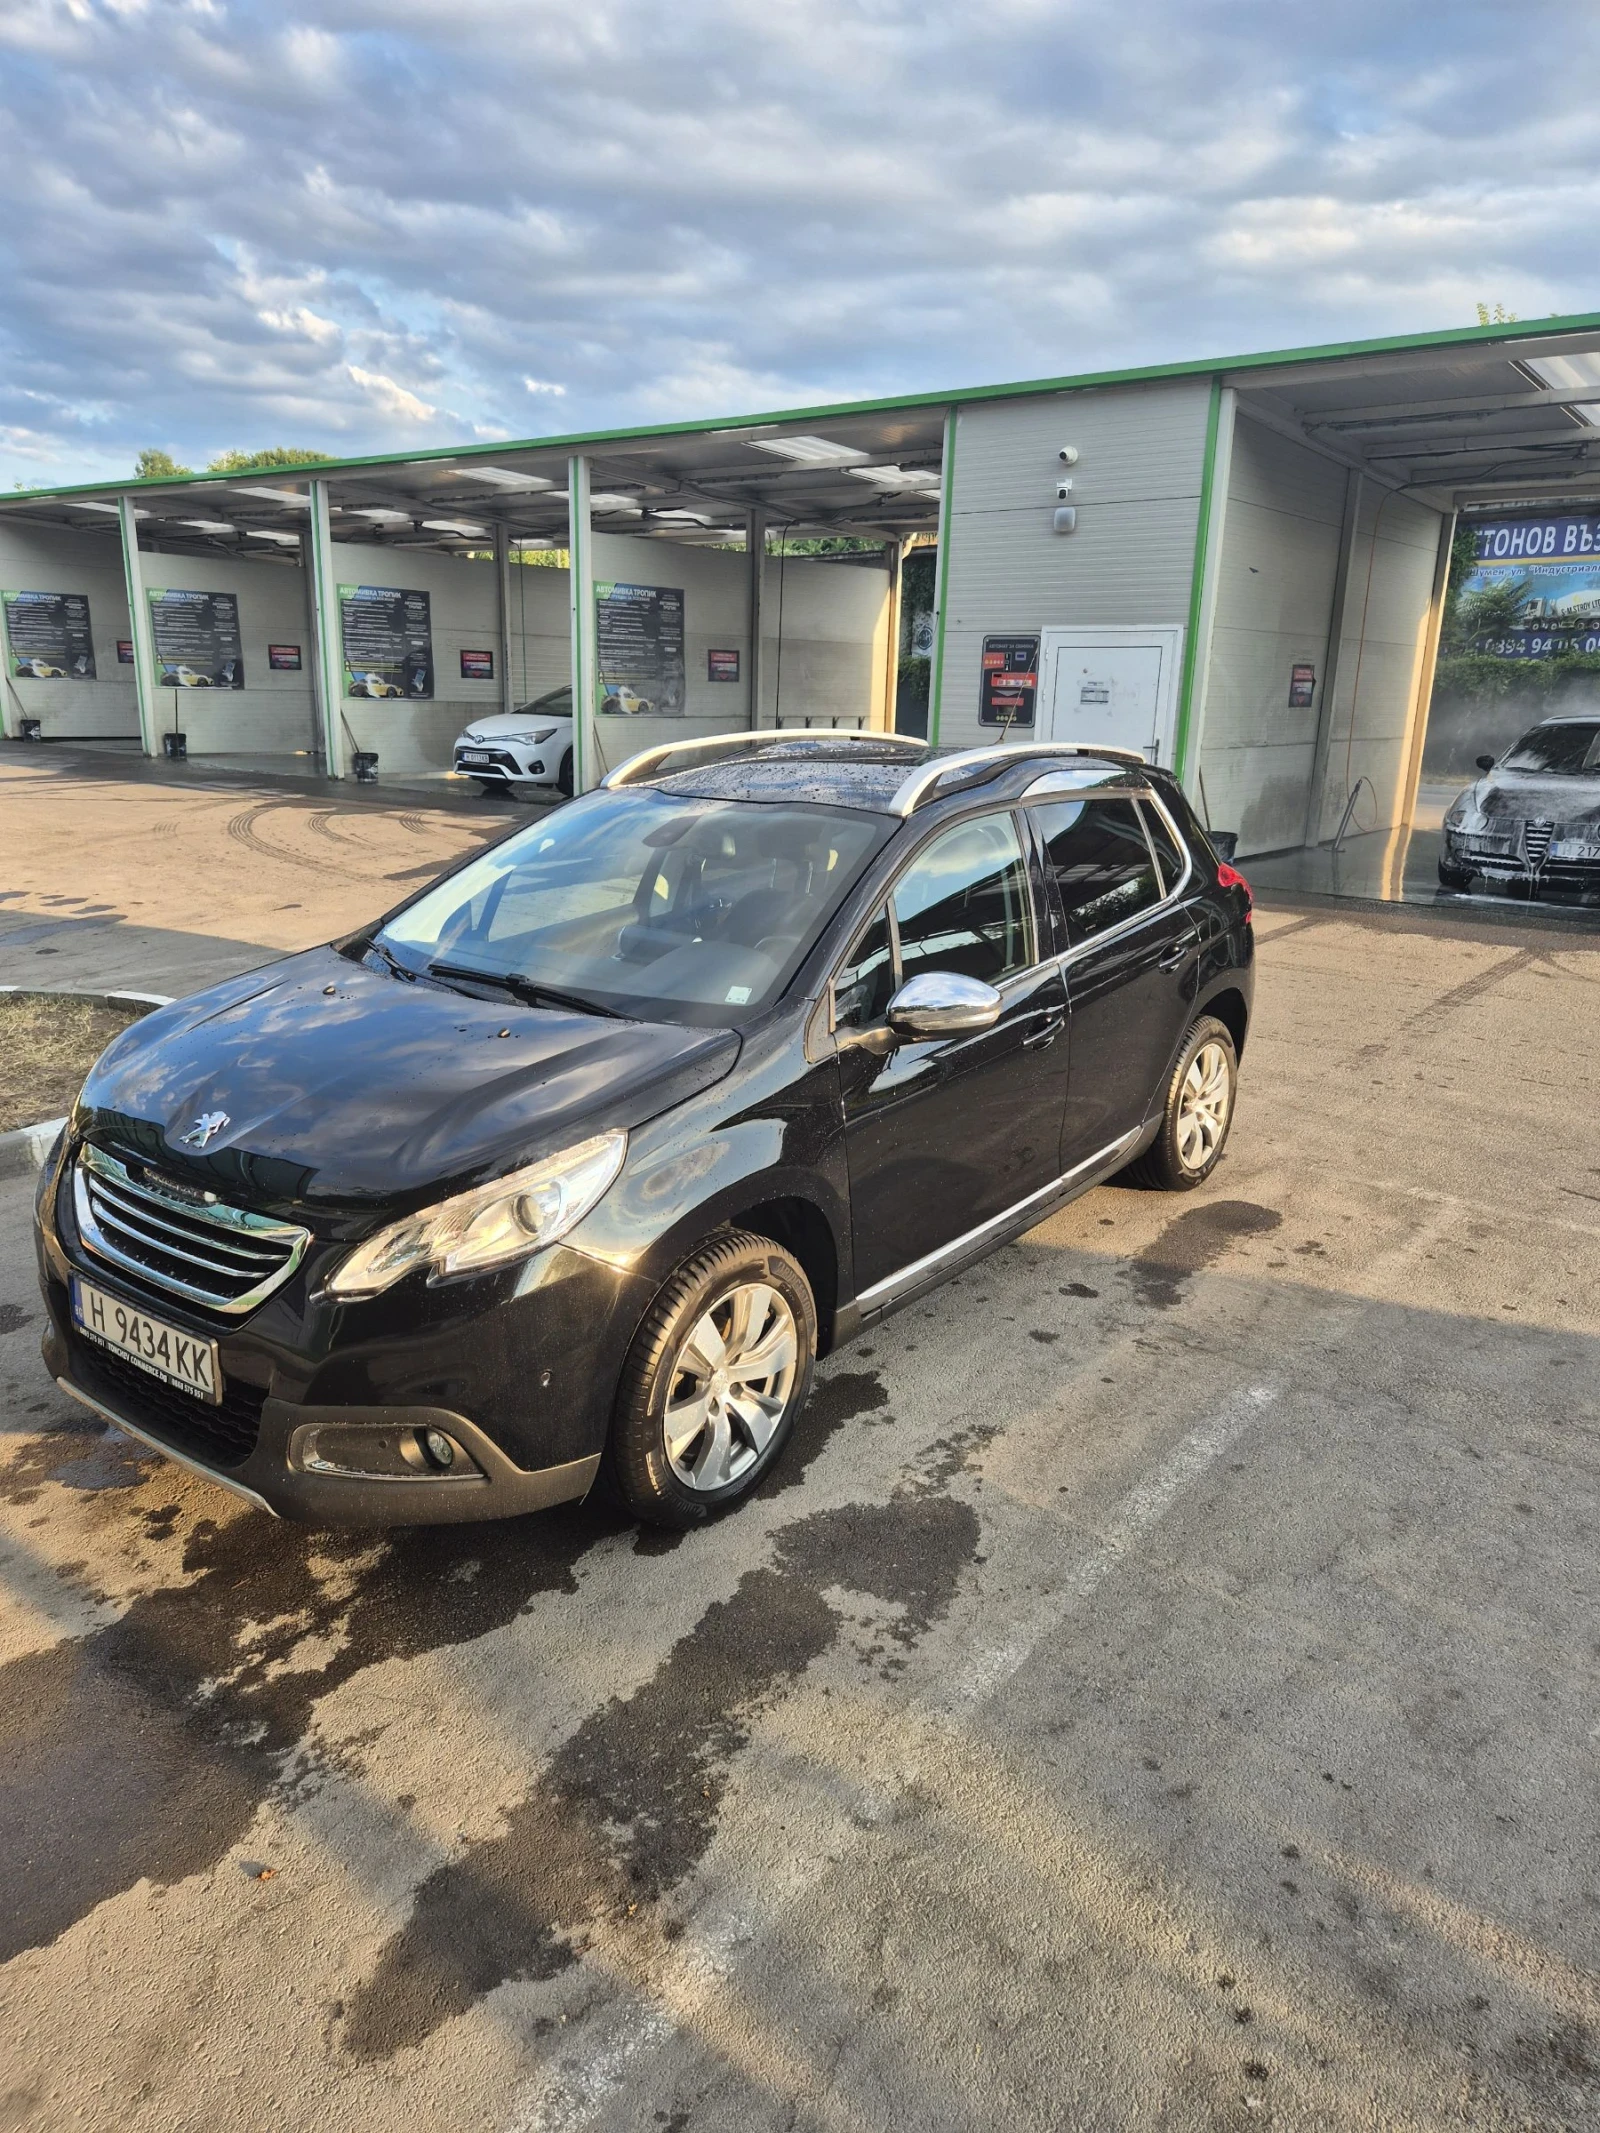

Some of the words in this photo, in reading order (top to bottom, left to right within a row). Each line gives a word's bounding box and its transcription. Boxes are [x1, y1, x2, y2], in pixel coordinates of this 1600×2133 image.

[1474, 526, 1556, 557] ТОНОВ
[1511, 568, 1525, 577] ул.
[340, 587, 377, 596] АВТОМИВКА
[377, 590, 402, 599] ТРОПИК
[596, 585, 633, 596] АВТОМИВКА
[633, 589, 657, 598] ТРОПИК
[1531, 637, 1553, 654] 94
[90, 1291, 106, 1333] H
